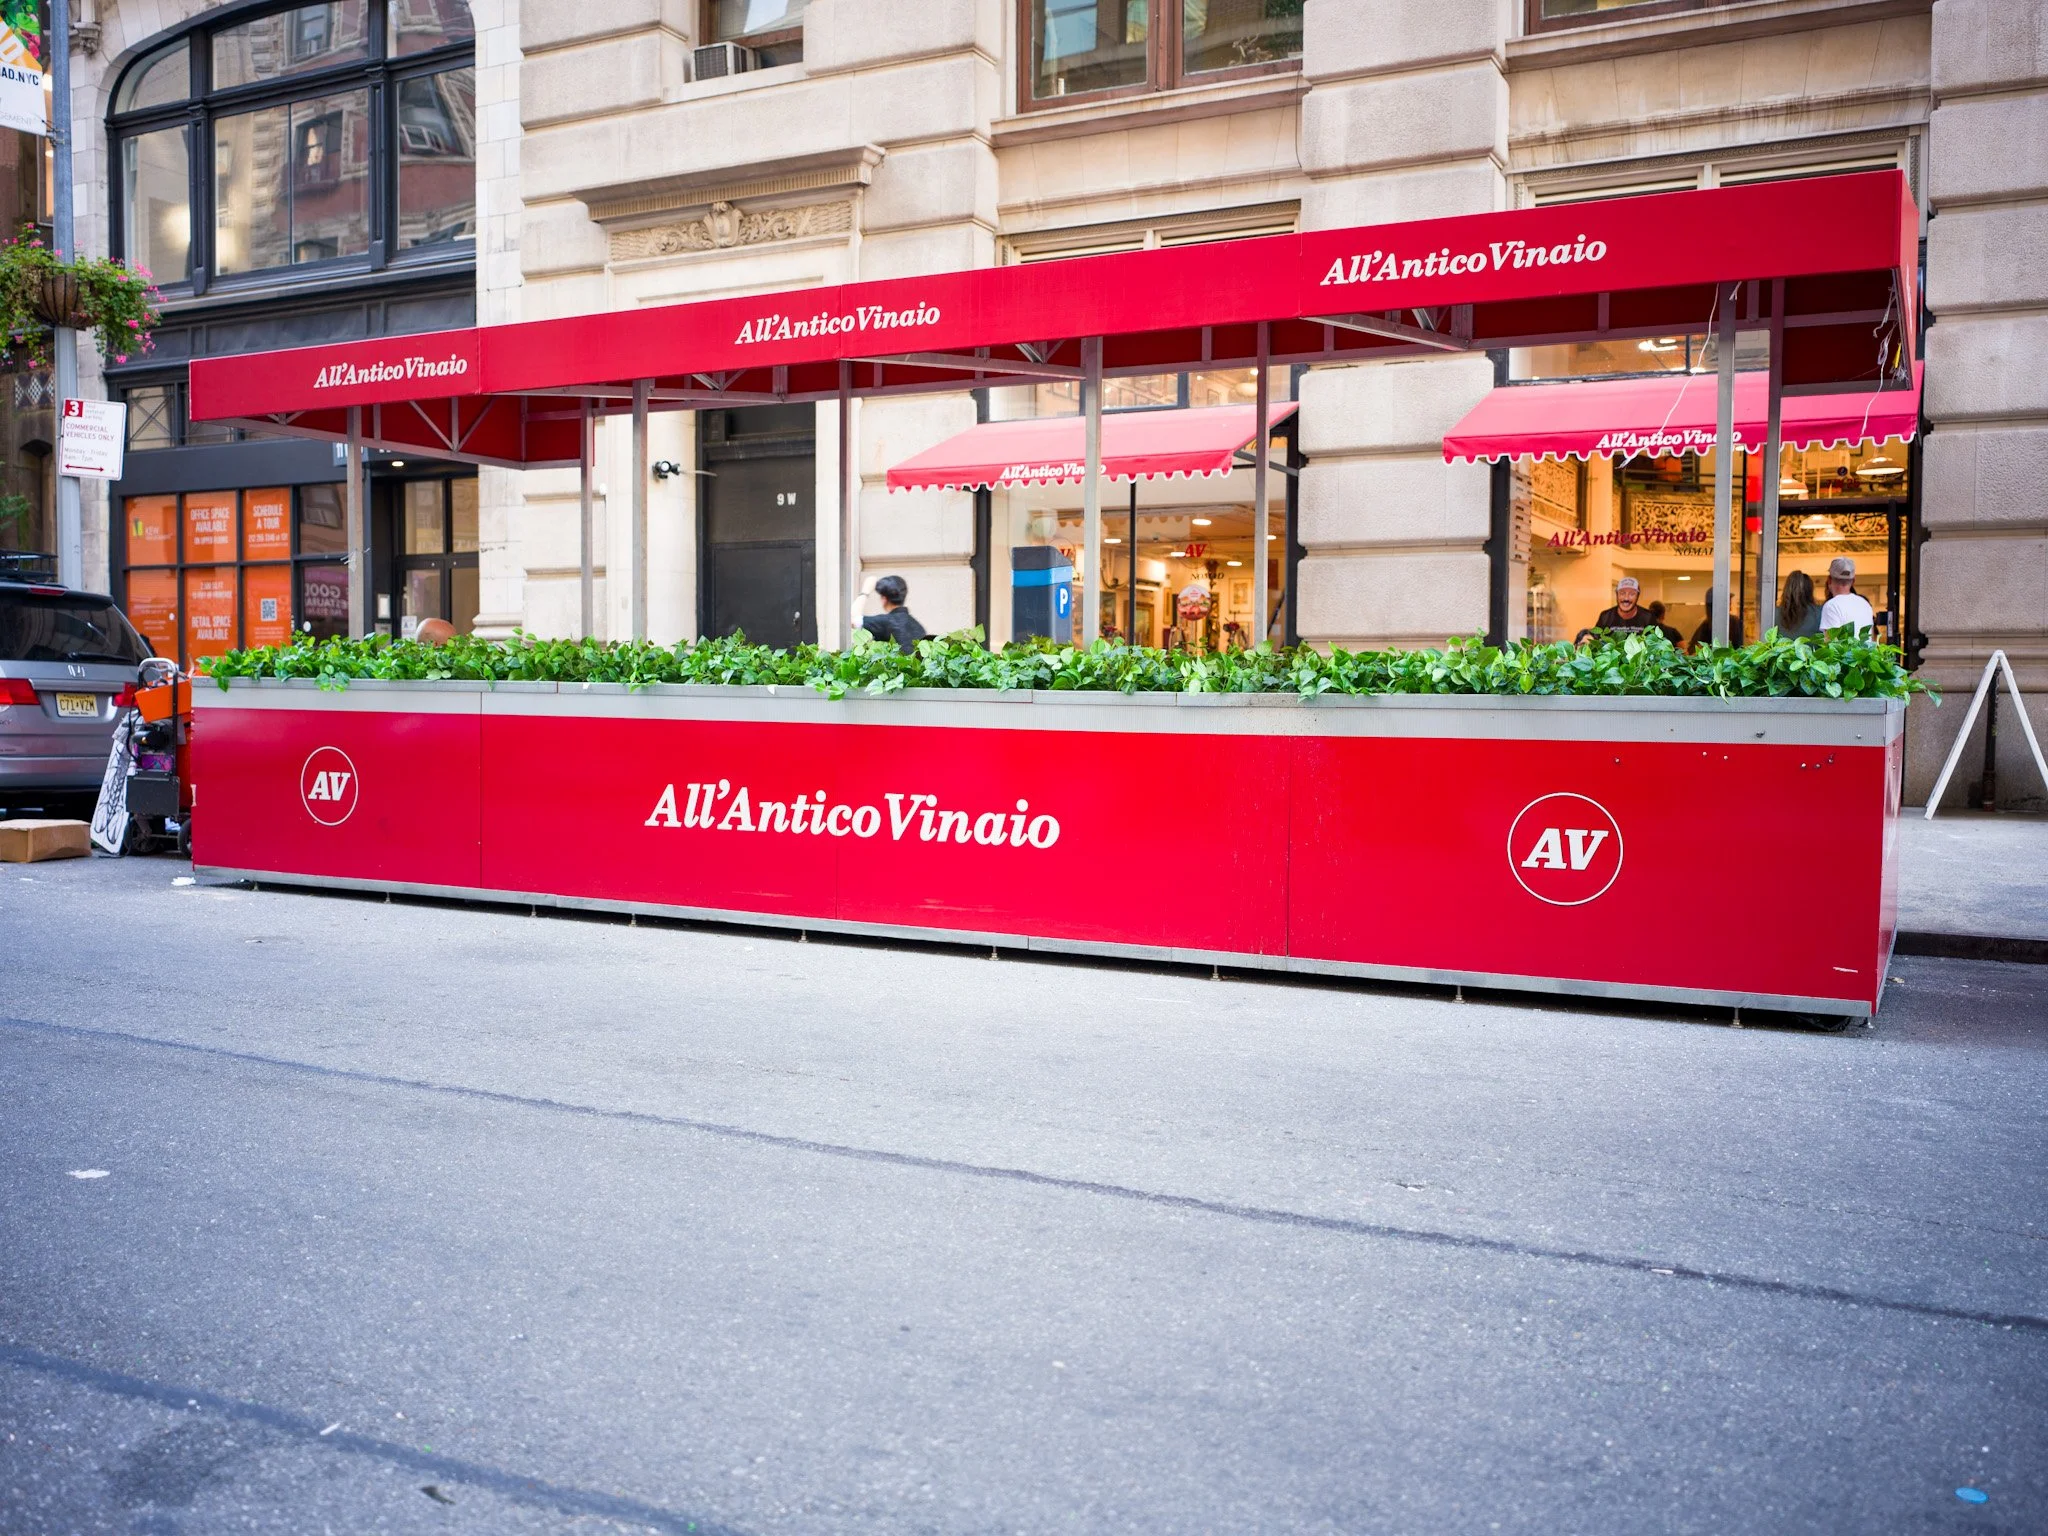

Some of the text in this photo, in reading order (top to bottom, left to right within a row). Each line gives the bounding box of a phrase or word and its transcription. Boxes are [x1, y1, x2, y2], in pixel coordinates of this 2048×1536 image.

[0, 66, 39, 86] AD.NYC
[68, 401, 80, 416] 3
[65, 422, 108, 433] COMMERCIAL
[65, 431, 115, 441] VEHICLES ONLY
[776, 492, 797, 506] 9 W
[190, 507, 230, 521] OFFICE SPACE
[252, 504, 283, 517] SCHEDULE
[195, 520, 228, 533] AVAILABLE
[263, 517, 280, 530] TOUR
[1184, 543, 1208, 558] AV
[1060, 587, 1069, 614] P
[191, 615, 232, 628] RETAIL SPACE
[196, 628, 229, 640] AVAILABLE
[307, 771, 351, 801] AV
[1521, 828, 1609, 871] AV
